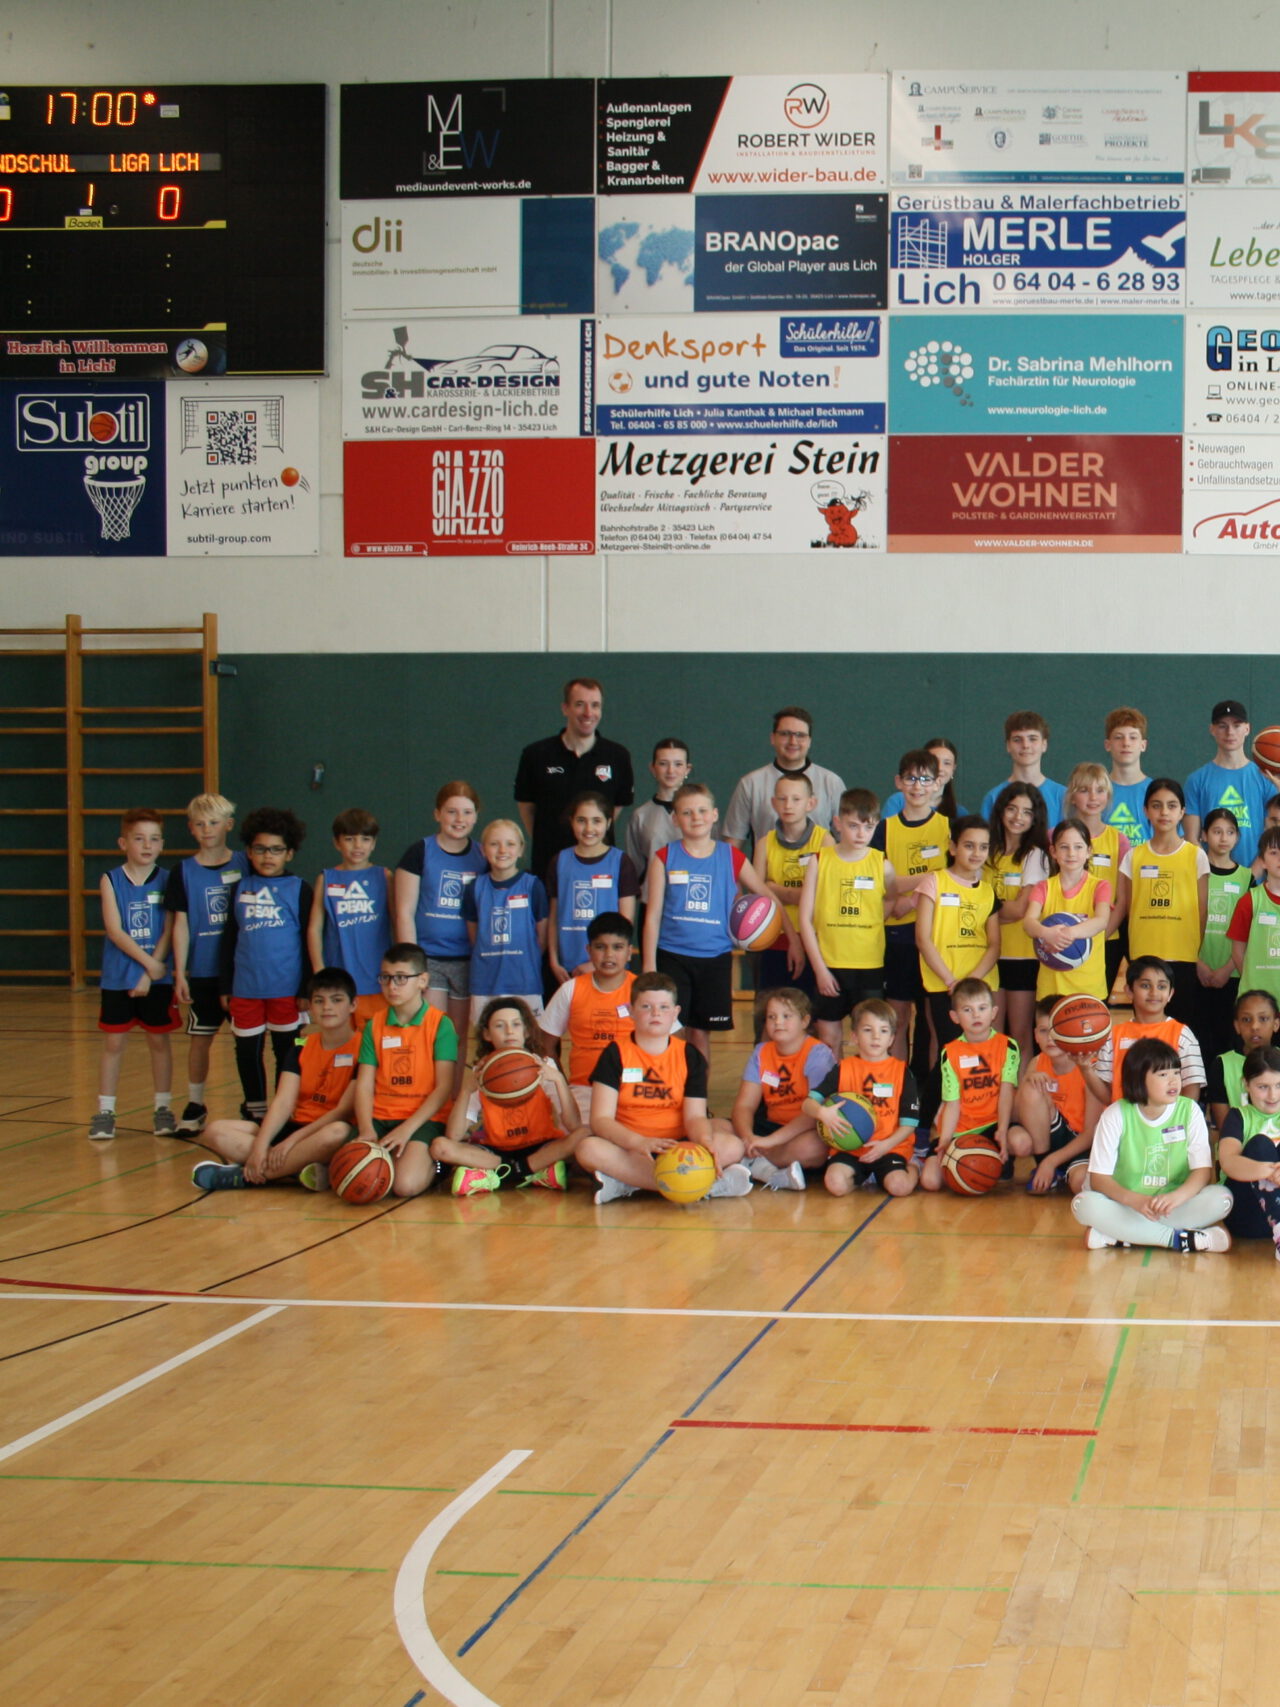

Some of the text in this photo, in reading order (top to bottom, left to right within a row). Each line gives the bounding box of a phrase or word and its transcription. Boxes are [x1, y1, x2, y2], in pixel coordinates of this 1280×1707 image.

[47, 93, 137, 125] 17:00
[606, 102, 691, 115] Außenanlagen
[606, 117, 671, 129] Spenglerei
[606, 132, 666, 144] Heizung &
[737, 132, 876, 148] ROBERT WIDER
[607, 146, 650, 157] Sanitär
[110, 153, 199, 172] LIGA LICH
[606, 160, 660, 173] Bagger &
[607, 174, 684, 186] Kranarbeiten
[708, 168, 877, 184] www.wider-bau.de
[396, 180, 531, 193] mediaundevent-works.de
[897, 194, 1180, 211] Gerüstbau & Malerfachbetrieb
[352, 217, 402, 253] dii
[963, 217, 1112, 252] MERLE
[705, 231, 839, 256] BRANOpac
[724, 260, 877, 275] der Global Player aus Lich
[963, 254, 1020, 266] HOLGER
[898, 273, 981, 305] Lich
[8, 340, 168, 355] Herzlich Willkommen
[602, 331, 767, 363] Denksport
[60, 359, 116, 373] in Lich!
[988, 357, 1173, 372] Dr. Sabrina Mehlhorn
[1238, 356, 1258, 372] in
[427, 375, 560, 388] CAR-DESIGN
[644, 366, 841, 393] und gute Noten!
[988, 375, 1136, 389] Fachärztin für Neurologie
[362, 401, 559, 421] www.cardesign-lich.de
[610, 407, 864, 418] Schülerhilfe Lich Julia Kanthak & Michael Beckmann
[988, 406, 1107, 417] www.neurologie-lich.de
[23, 399, 145, 445] Subtil
[1197, 443, 1245, 455] Neuwagen
[84, 455, 148, 476] group
[599, 439, 880, 486] Metzgerei Stein
[965, 452, 1105, 478] VALDER
[1197, 459, 1273, 471] Gebrauchtwagen
[180, 472, 278, 499] Jetzt punkten
[432, 467, 504, 518] GIAZZO
[952, 482, 1118, 508] WOHNEN
[180, 495, 296, 519] Karriere starten!
[187, 534, 271, 544] subtil-group.com
[974, 539, 1094, 548] WWW.VALDER-WOHNEN.DE
[336, 900, 375, 915] PEAK
[440, 898, 462, 908] DBB
[687, 900, 709, 912] DBB
[1150, 898, 1171, 908] DBB
[244, 905, 283, 920] PEAK
[840, 906, 861, 916] DBB
[391, 1074, 414, 1086] DBB
[962, 1074, 999, 1091] PEAK
[632, 1084, 673, 1100] PEAK
